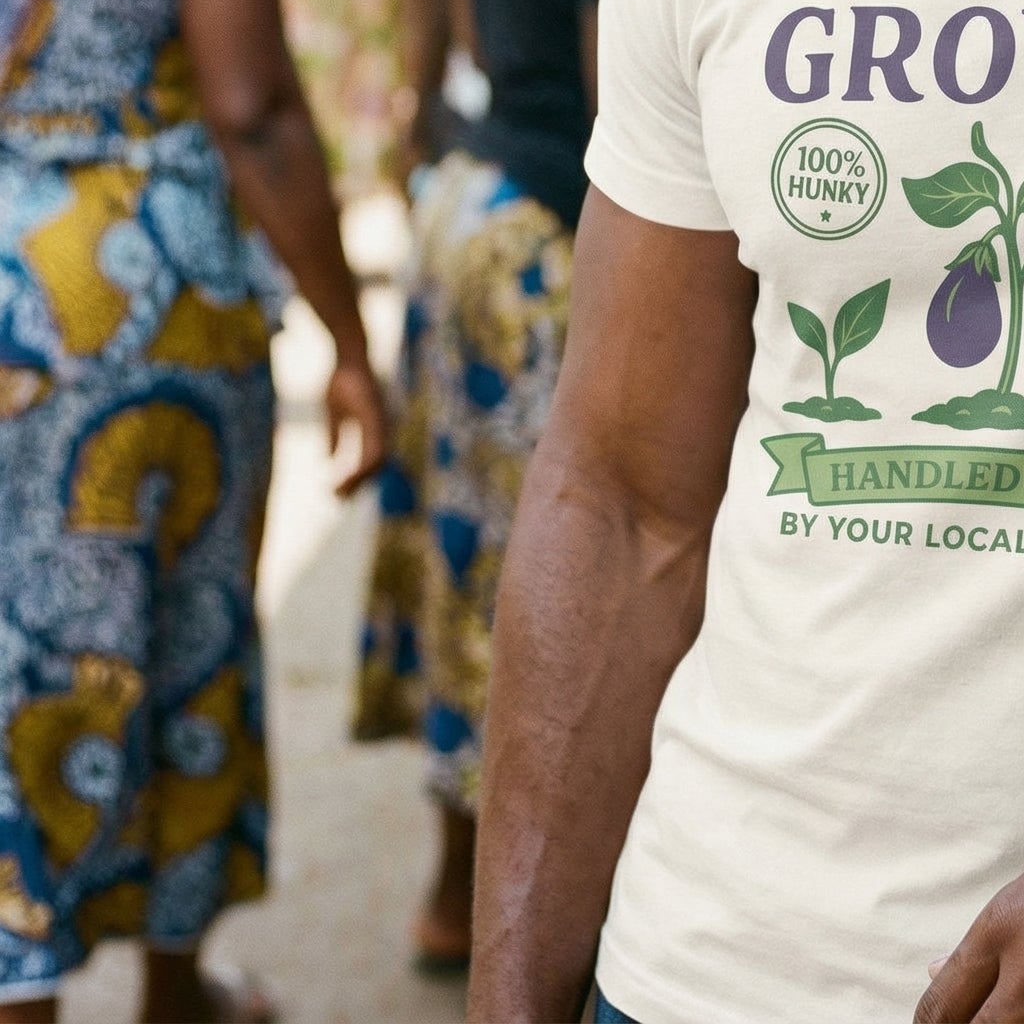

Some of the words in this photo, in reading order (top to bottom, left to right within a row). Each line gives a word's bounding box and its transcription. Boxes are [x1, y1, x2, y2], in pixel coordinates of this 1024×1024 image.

[797, 146, 866, 178] 100%
[788, 175, 870, 205] HUNKY
[830, 459, 1021, 493] HANDLED
[779, 511, 819, 538] BY
[827, 516, 913, 547] YOUR
